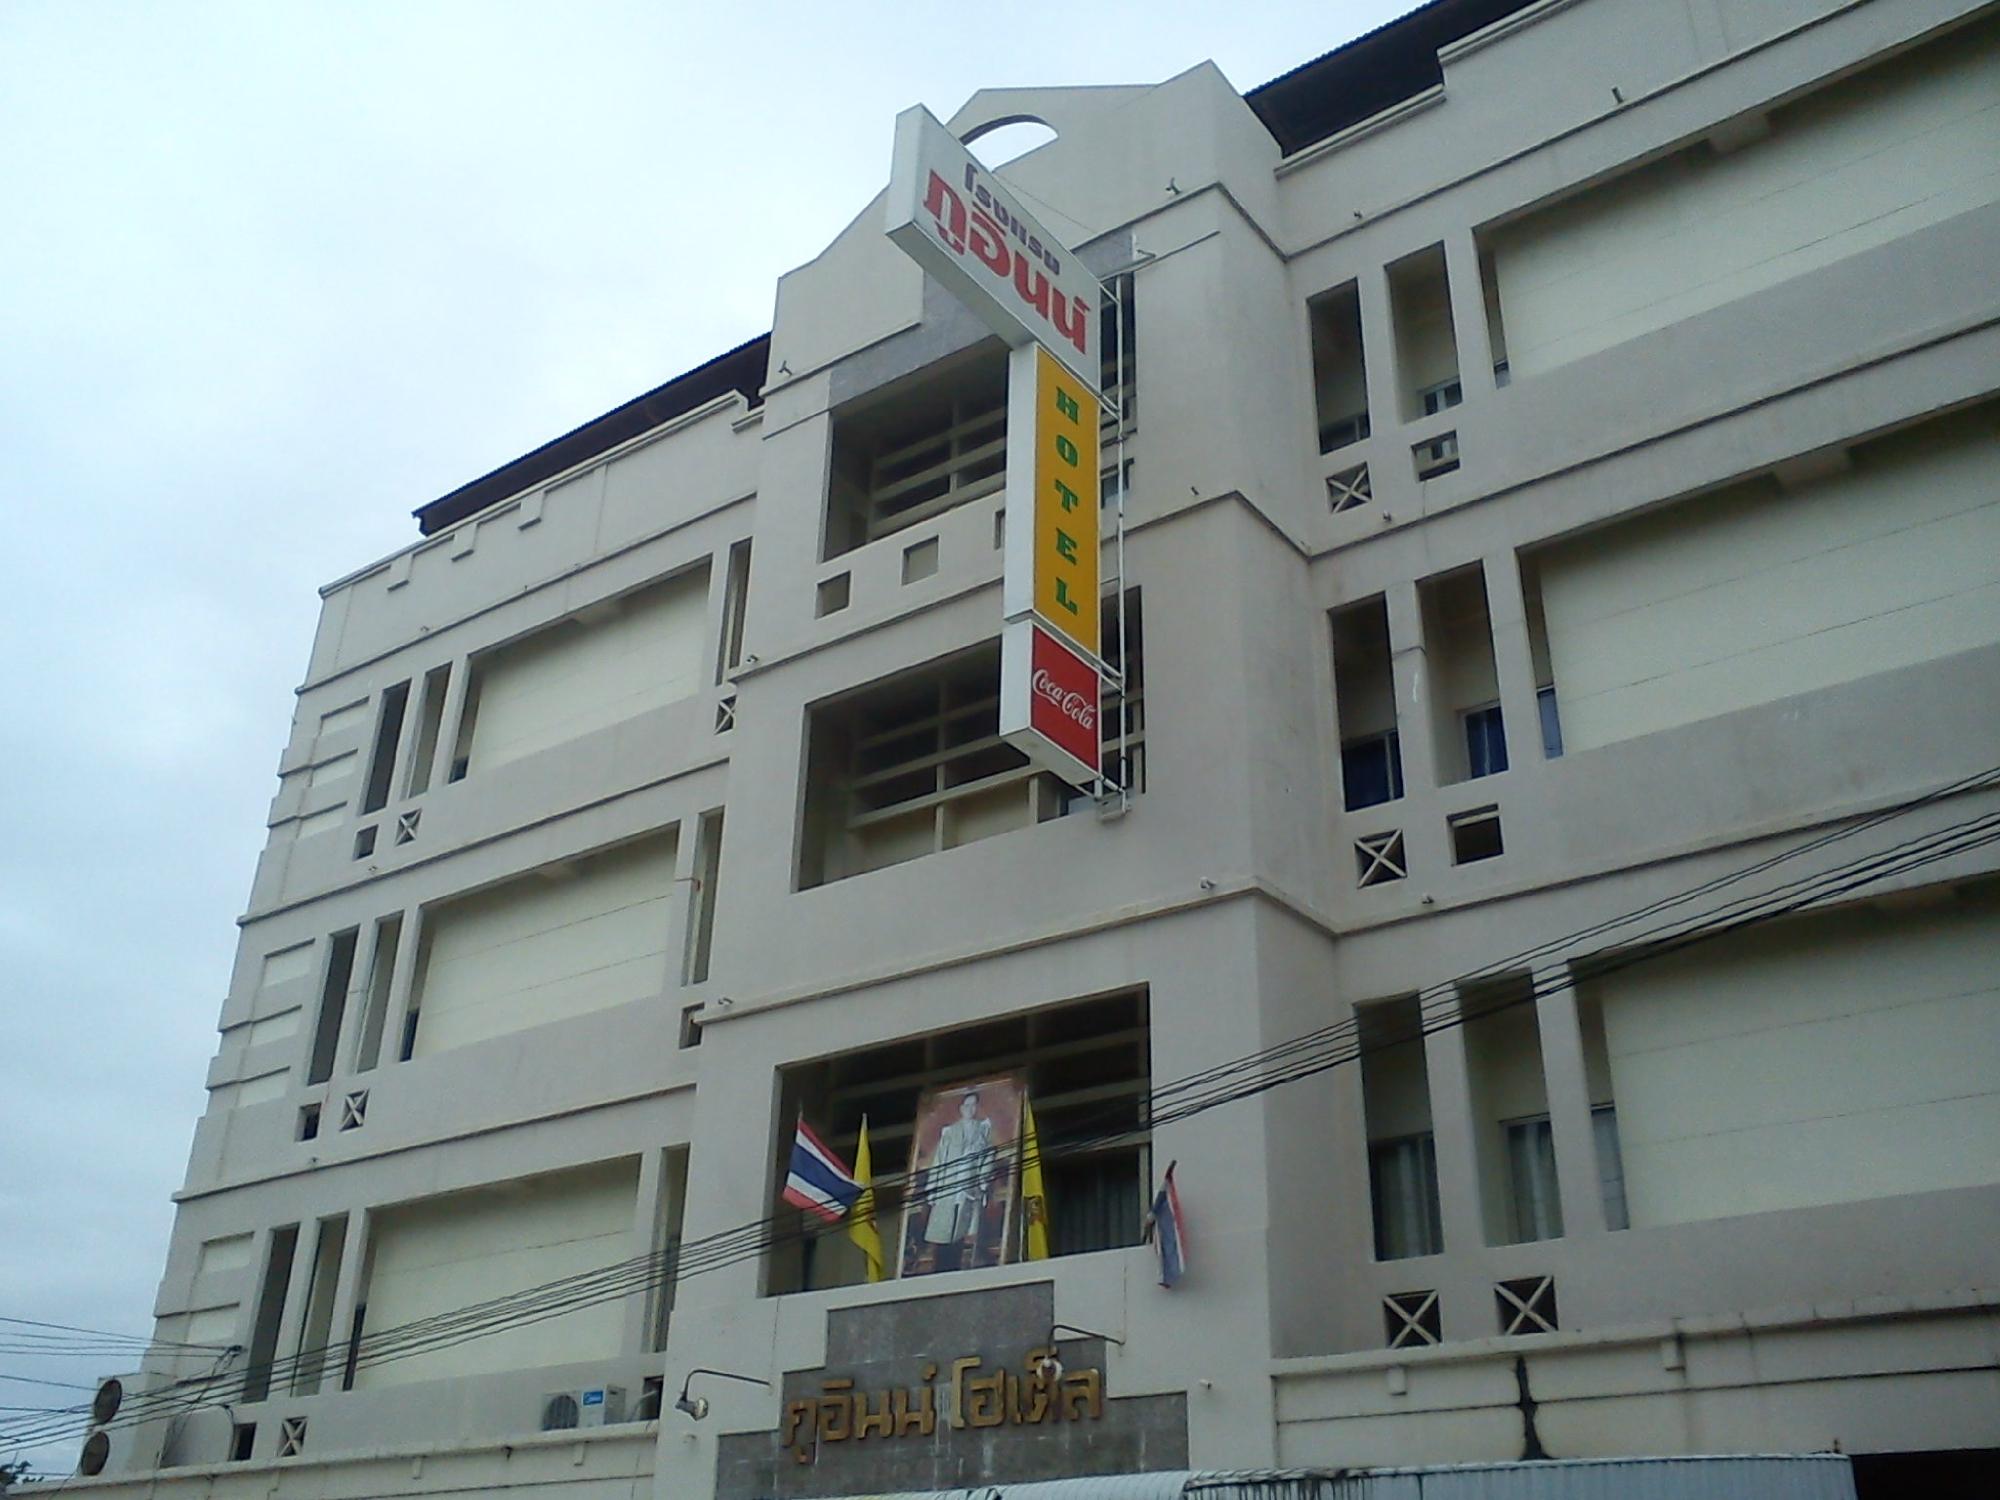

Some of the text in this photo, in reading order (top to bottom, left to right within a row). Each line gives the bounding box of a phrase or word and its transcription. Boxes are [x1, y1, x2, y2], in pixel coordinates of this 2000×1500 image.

[964, 163, 1061, 276] โรงแรม
[1055, 386, 1079, 616] HOTEL
[1032, 669, 1097, 730] Coca-Cola
